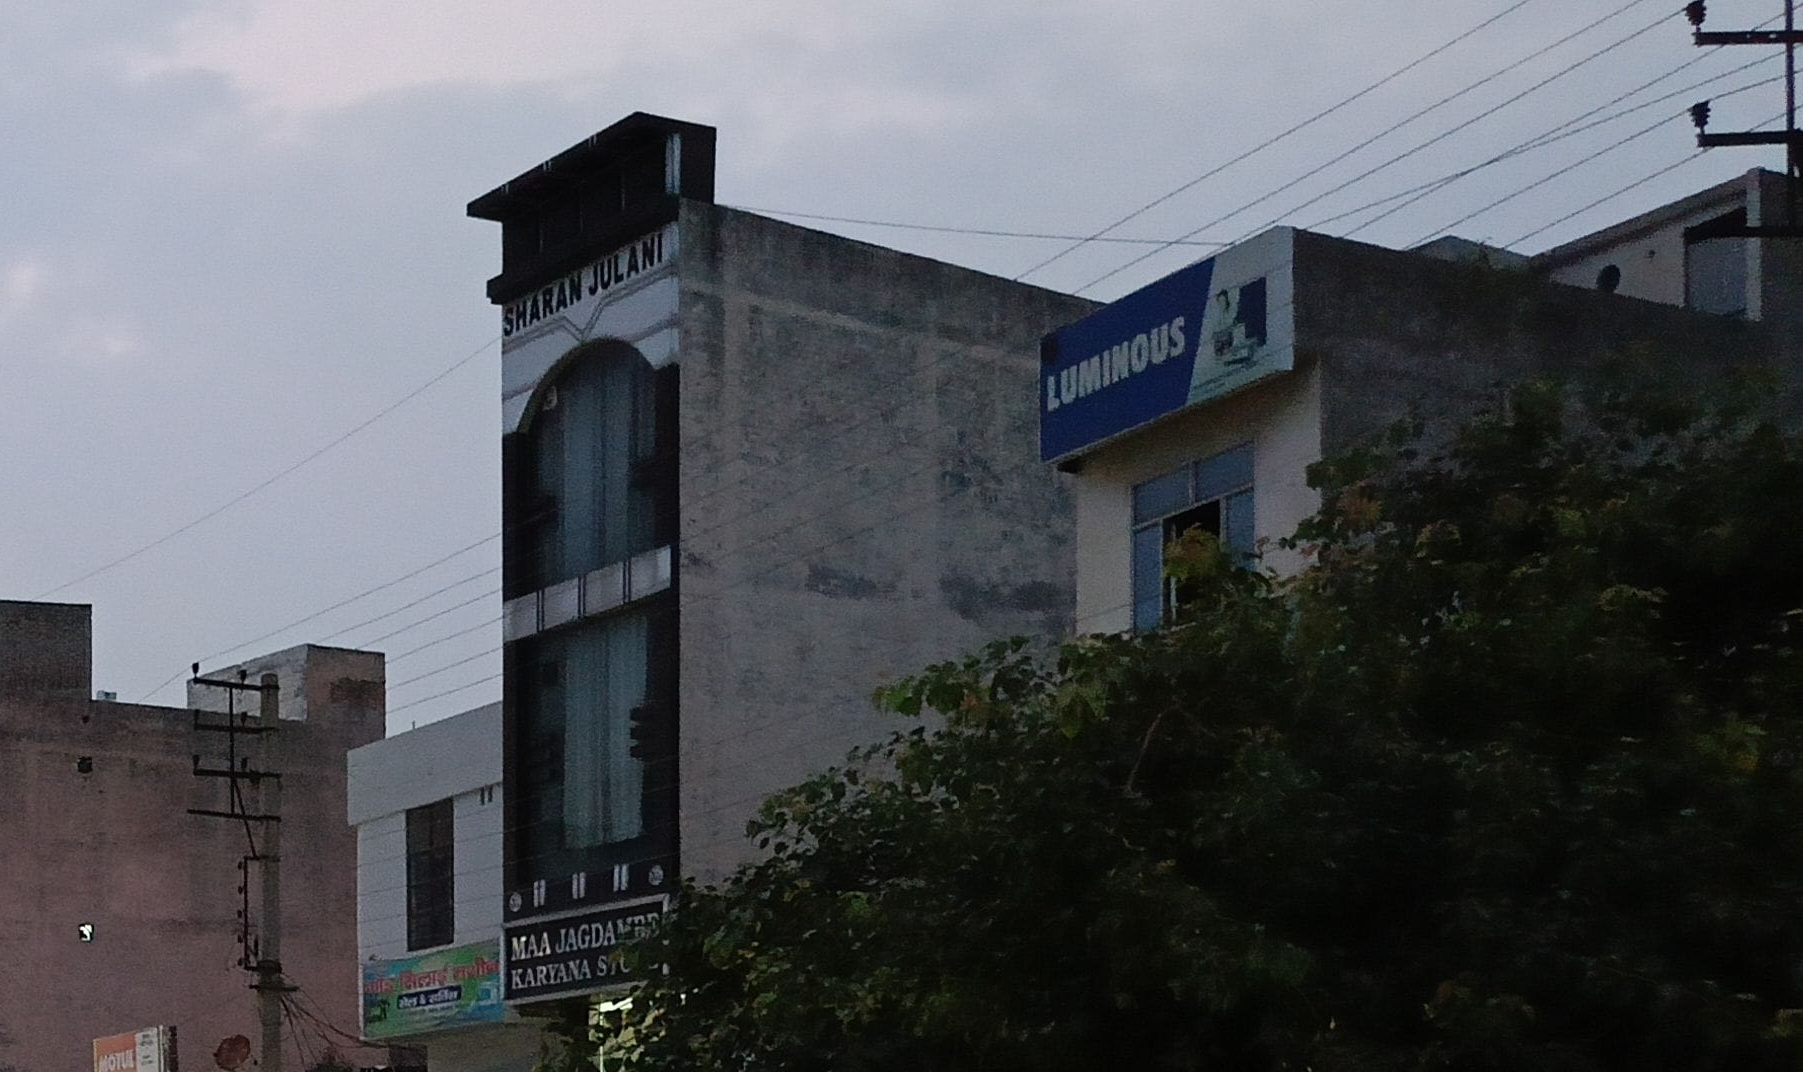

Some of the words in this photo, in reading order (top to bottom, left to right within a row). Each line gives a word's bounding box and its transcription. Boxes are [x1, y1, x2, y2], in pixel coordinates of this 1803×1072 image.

[503, 271, 582, 337] SHARAN
[588, 231, 664, 297] JULANI
[1046, 315, 1186, 412] LUMINOUS
[510, 931, 552, 961] MAA
[510, 959, 592, 990] KARYANA
